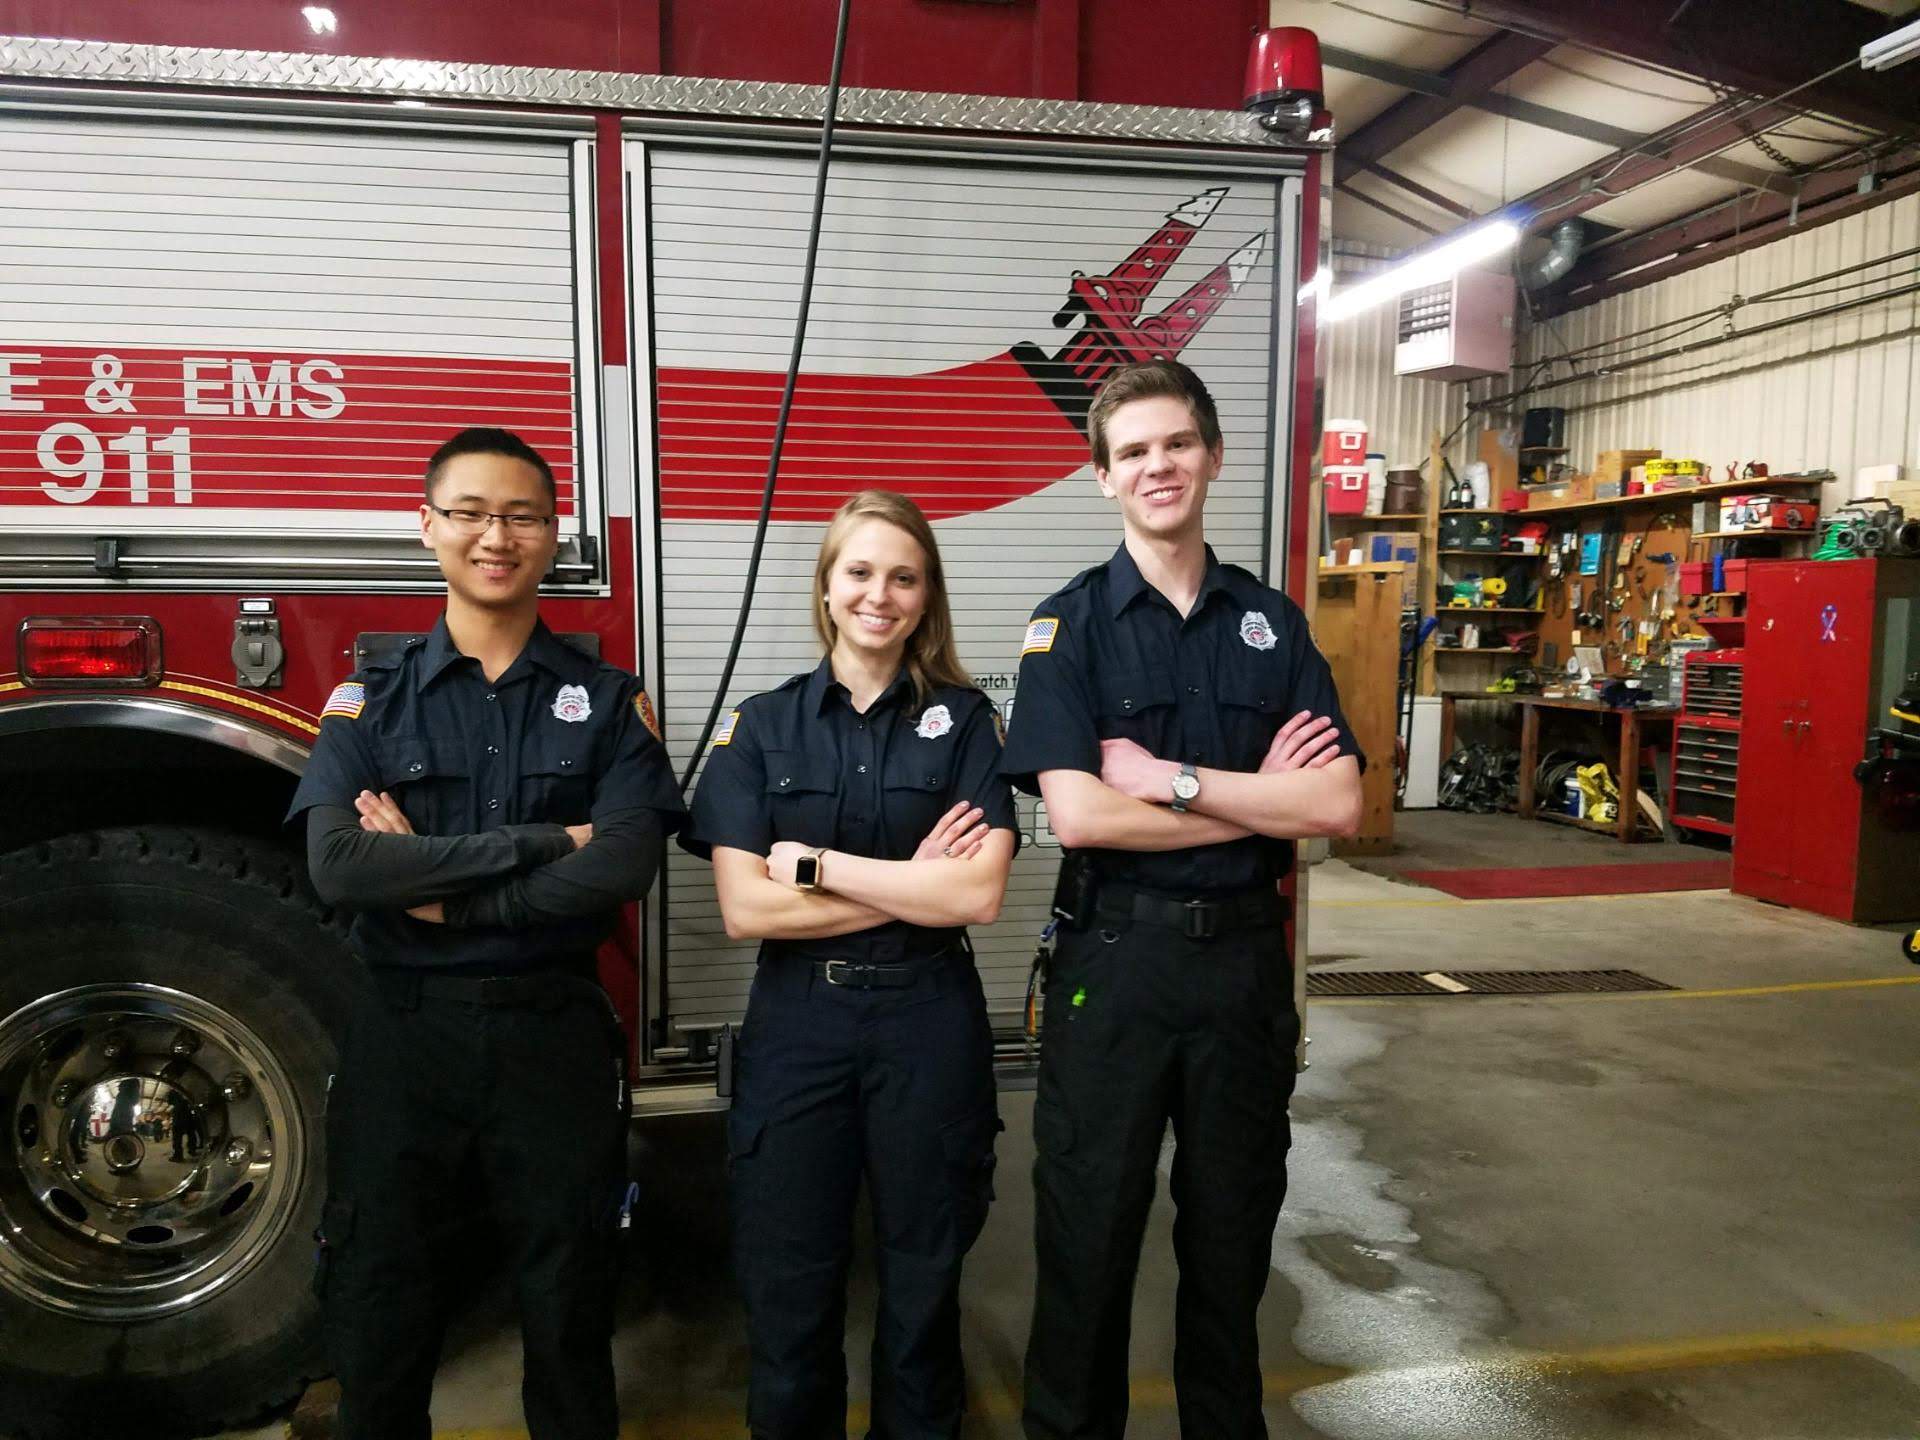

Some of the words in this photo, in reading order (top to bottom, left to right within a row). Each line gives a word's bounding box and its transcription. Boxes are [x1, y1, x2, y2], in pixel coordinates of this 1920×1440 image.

[0, 353, 44, 411] E
[84, 354, 137, 413] &
[182, 357, 346, 419] EMS
[37, 422, 193, 504] 911
